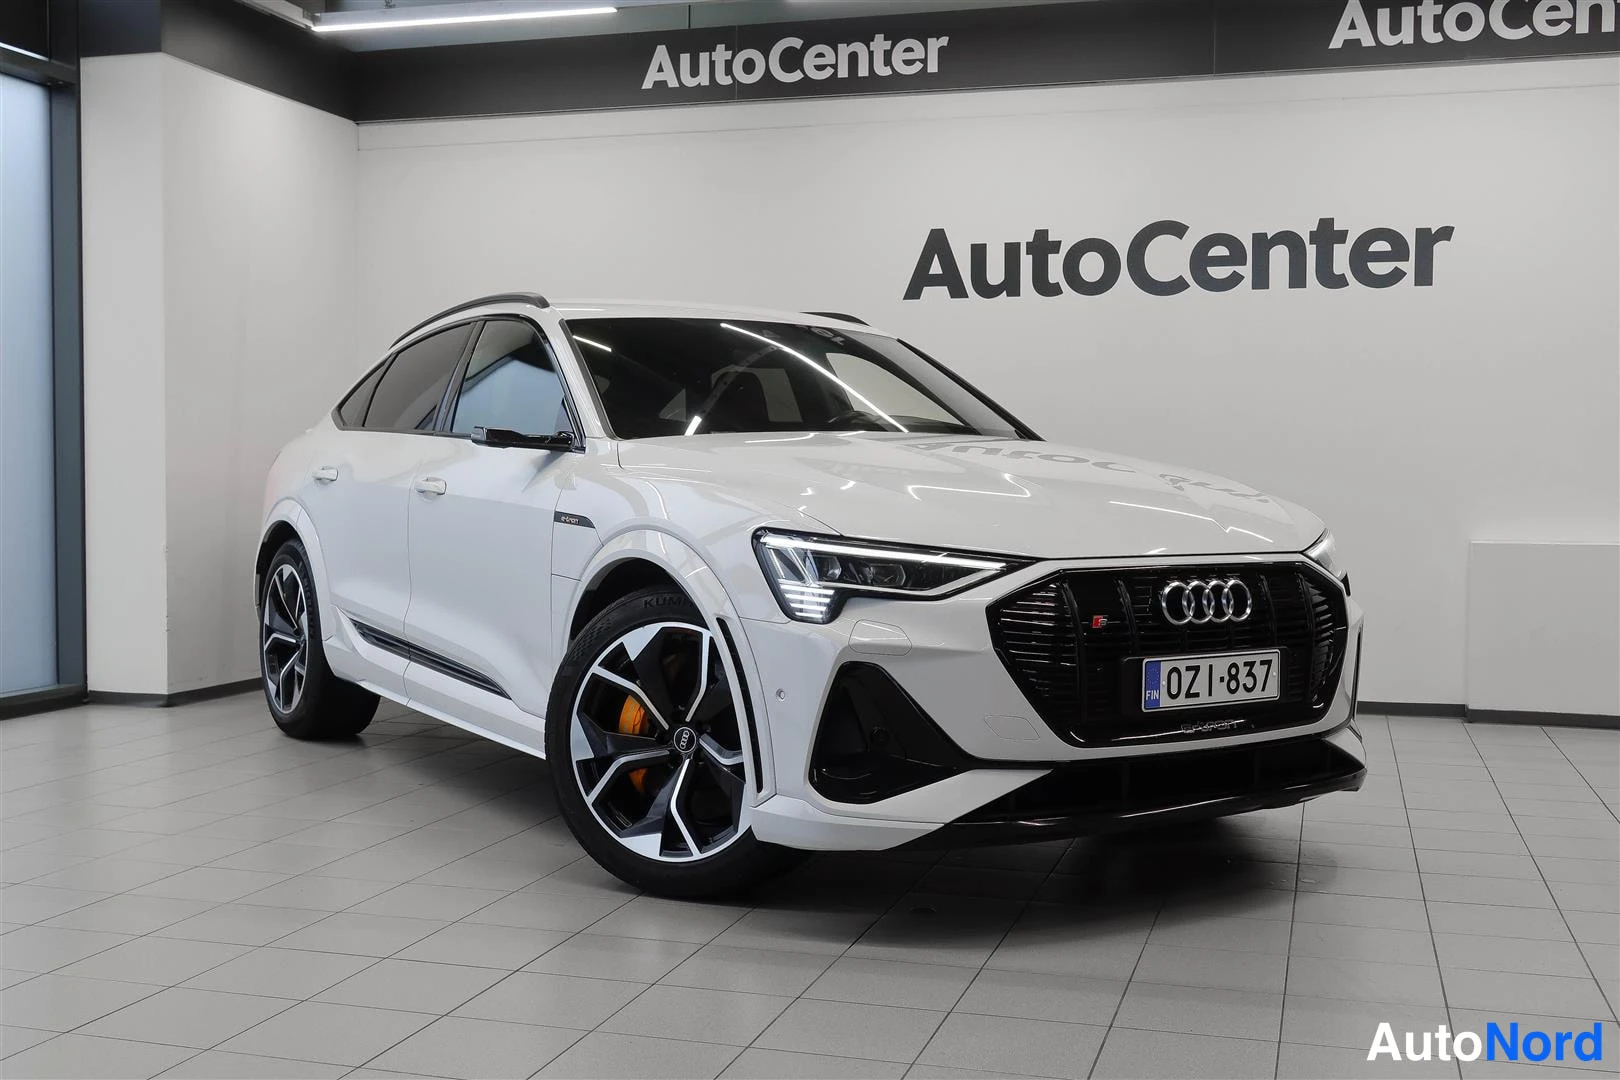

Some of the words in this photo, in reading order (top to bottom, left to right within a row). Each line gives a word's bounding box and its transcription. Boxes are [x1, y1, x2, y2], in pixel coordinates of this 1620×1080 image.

[1328, 0, 1620, 49] AutoCen
[641, 34, 949, 89] AutoCenter
[903, 217, 1455, 300] AutoCenter
[1146, 690, 1159, 701] FIN
[1166, 659, 1273, 700] OZI-837
